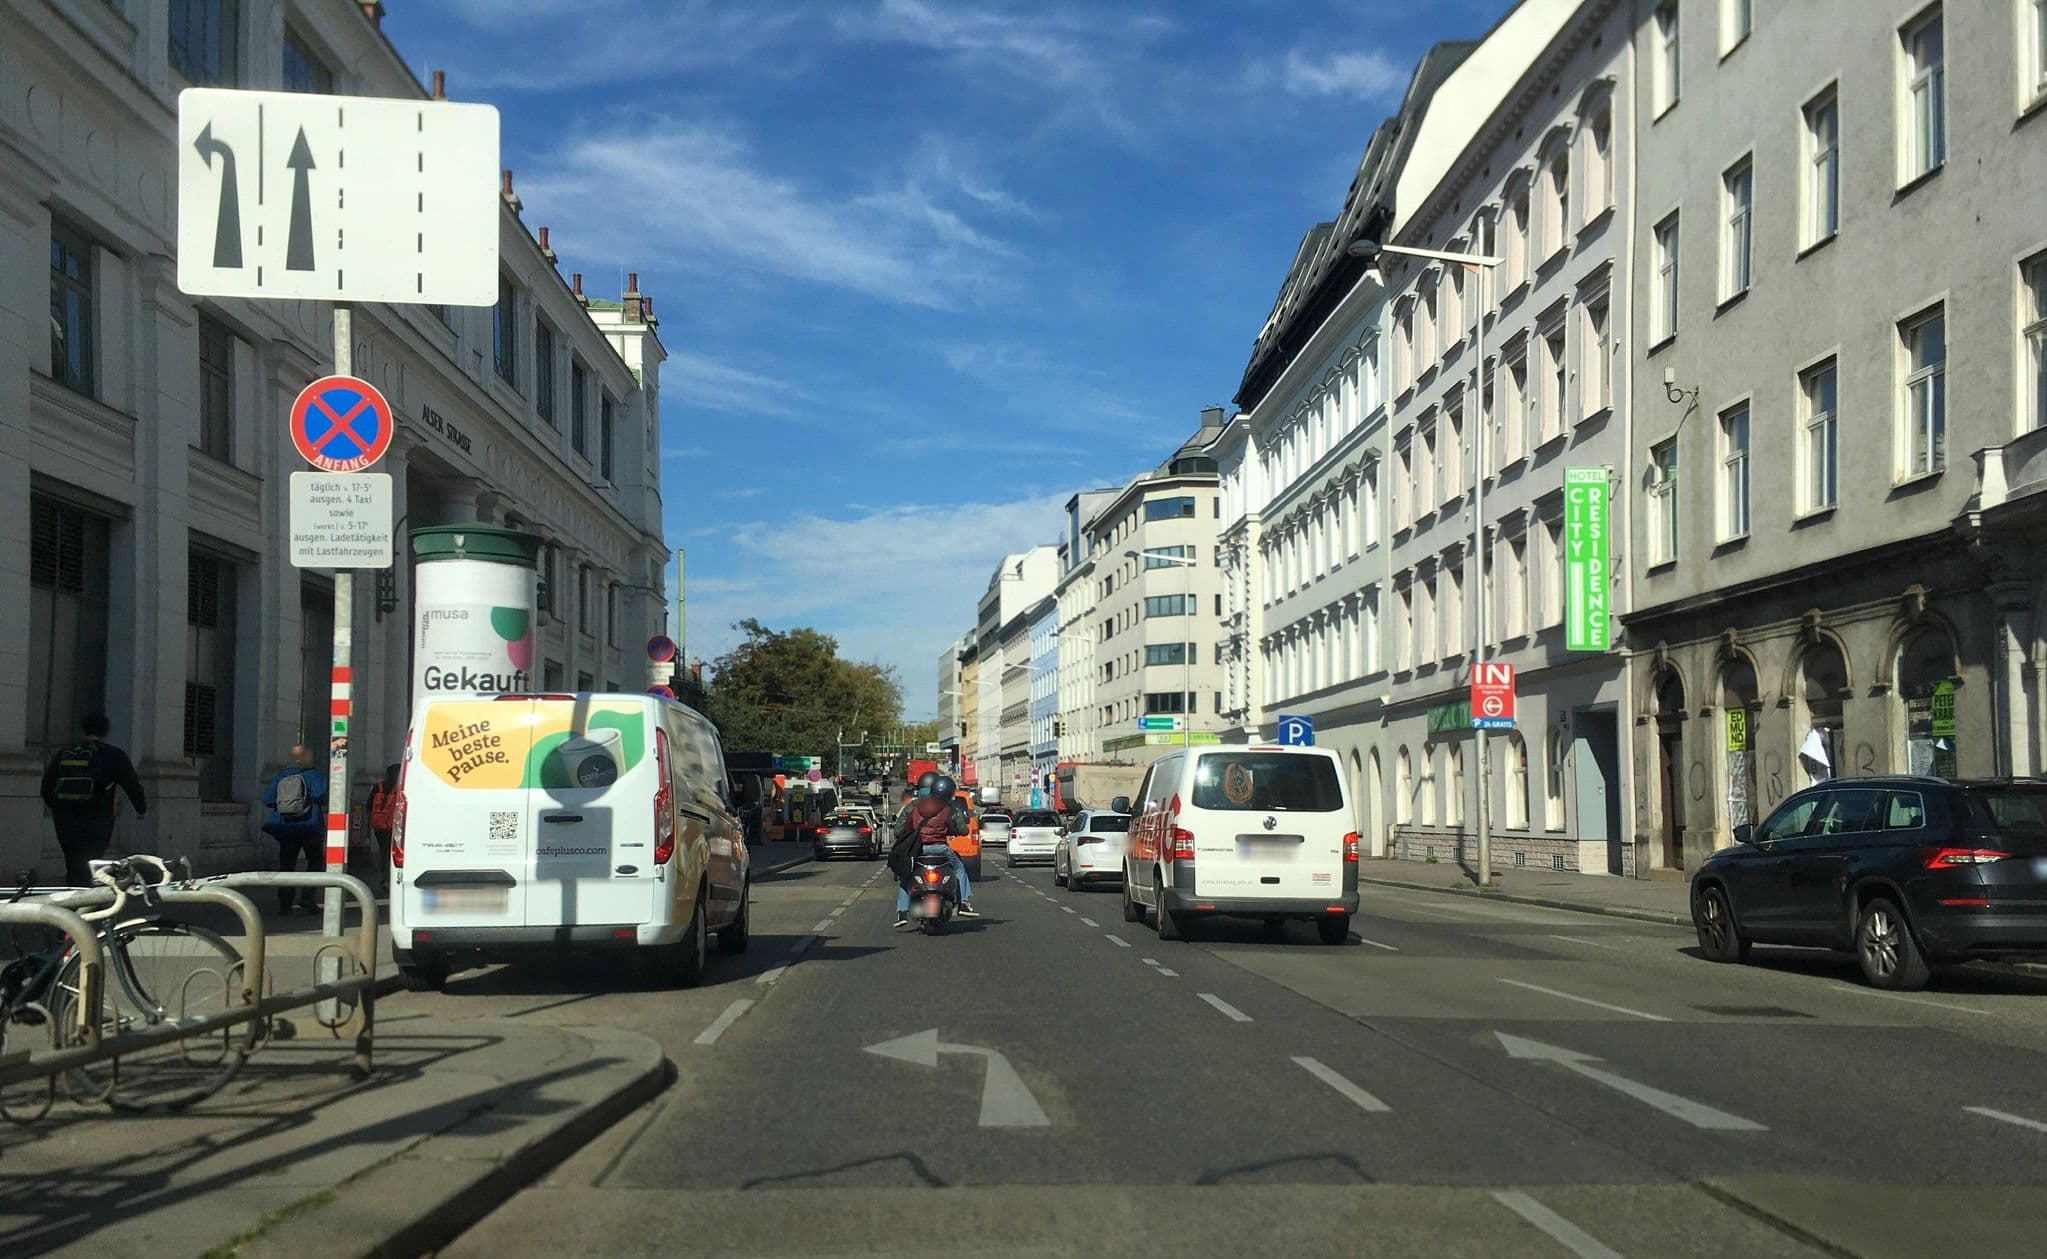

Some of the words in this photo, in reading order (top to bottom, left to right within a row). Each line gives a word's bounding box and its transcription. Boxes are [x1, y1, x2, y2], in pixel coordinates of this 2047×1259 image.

[314, 455, 369, 471] ANFANG
[1570, 471, 1604, 481] HOTEL
[311, 482, 341, 492] täglich
[310, 495, 342, 505] ausgen.
[346, 496, 352, 504] 4
[354, 495, 372, 504] Taxi
[328, 509, 354, 518] sowie
[1570, 488, 1584, 557] CITY
[294, 534, 327, 544] ausgen.
[330, 533, 388, 544] Ladetätigkeit
[299, 547, 314, 556] mit
[317, 547, 384, 557] Lastfahrzeugen
[1589, 488, 1603, 645] RESIDENCE
[431, 610, 469, 620] musa
[424, 665, 530, 692] Gekauft
[1475, 664, 1510, 685] IN
[1731, 711, 1743, 722] ED
[1289, 723, 1304, 743] P
[1730, 722, 1744, 733] MU
[432, 720, 490, 748] Meine
[1731, 733, 1744, 744] ND
[448, 735, 501, 761] beste
[447, 751, 510, 783] Pause.
[536, 846, 607, 857] cafeplusco.com
